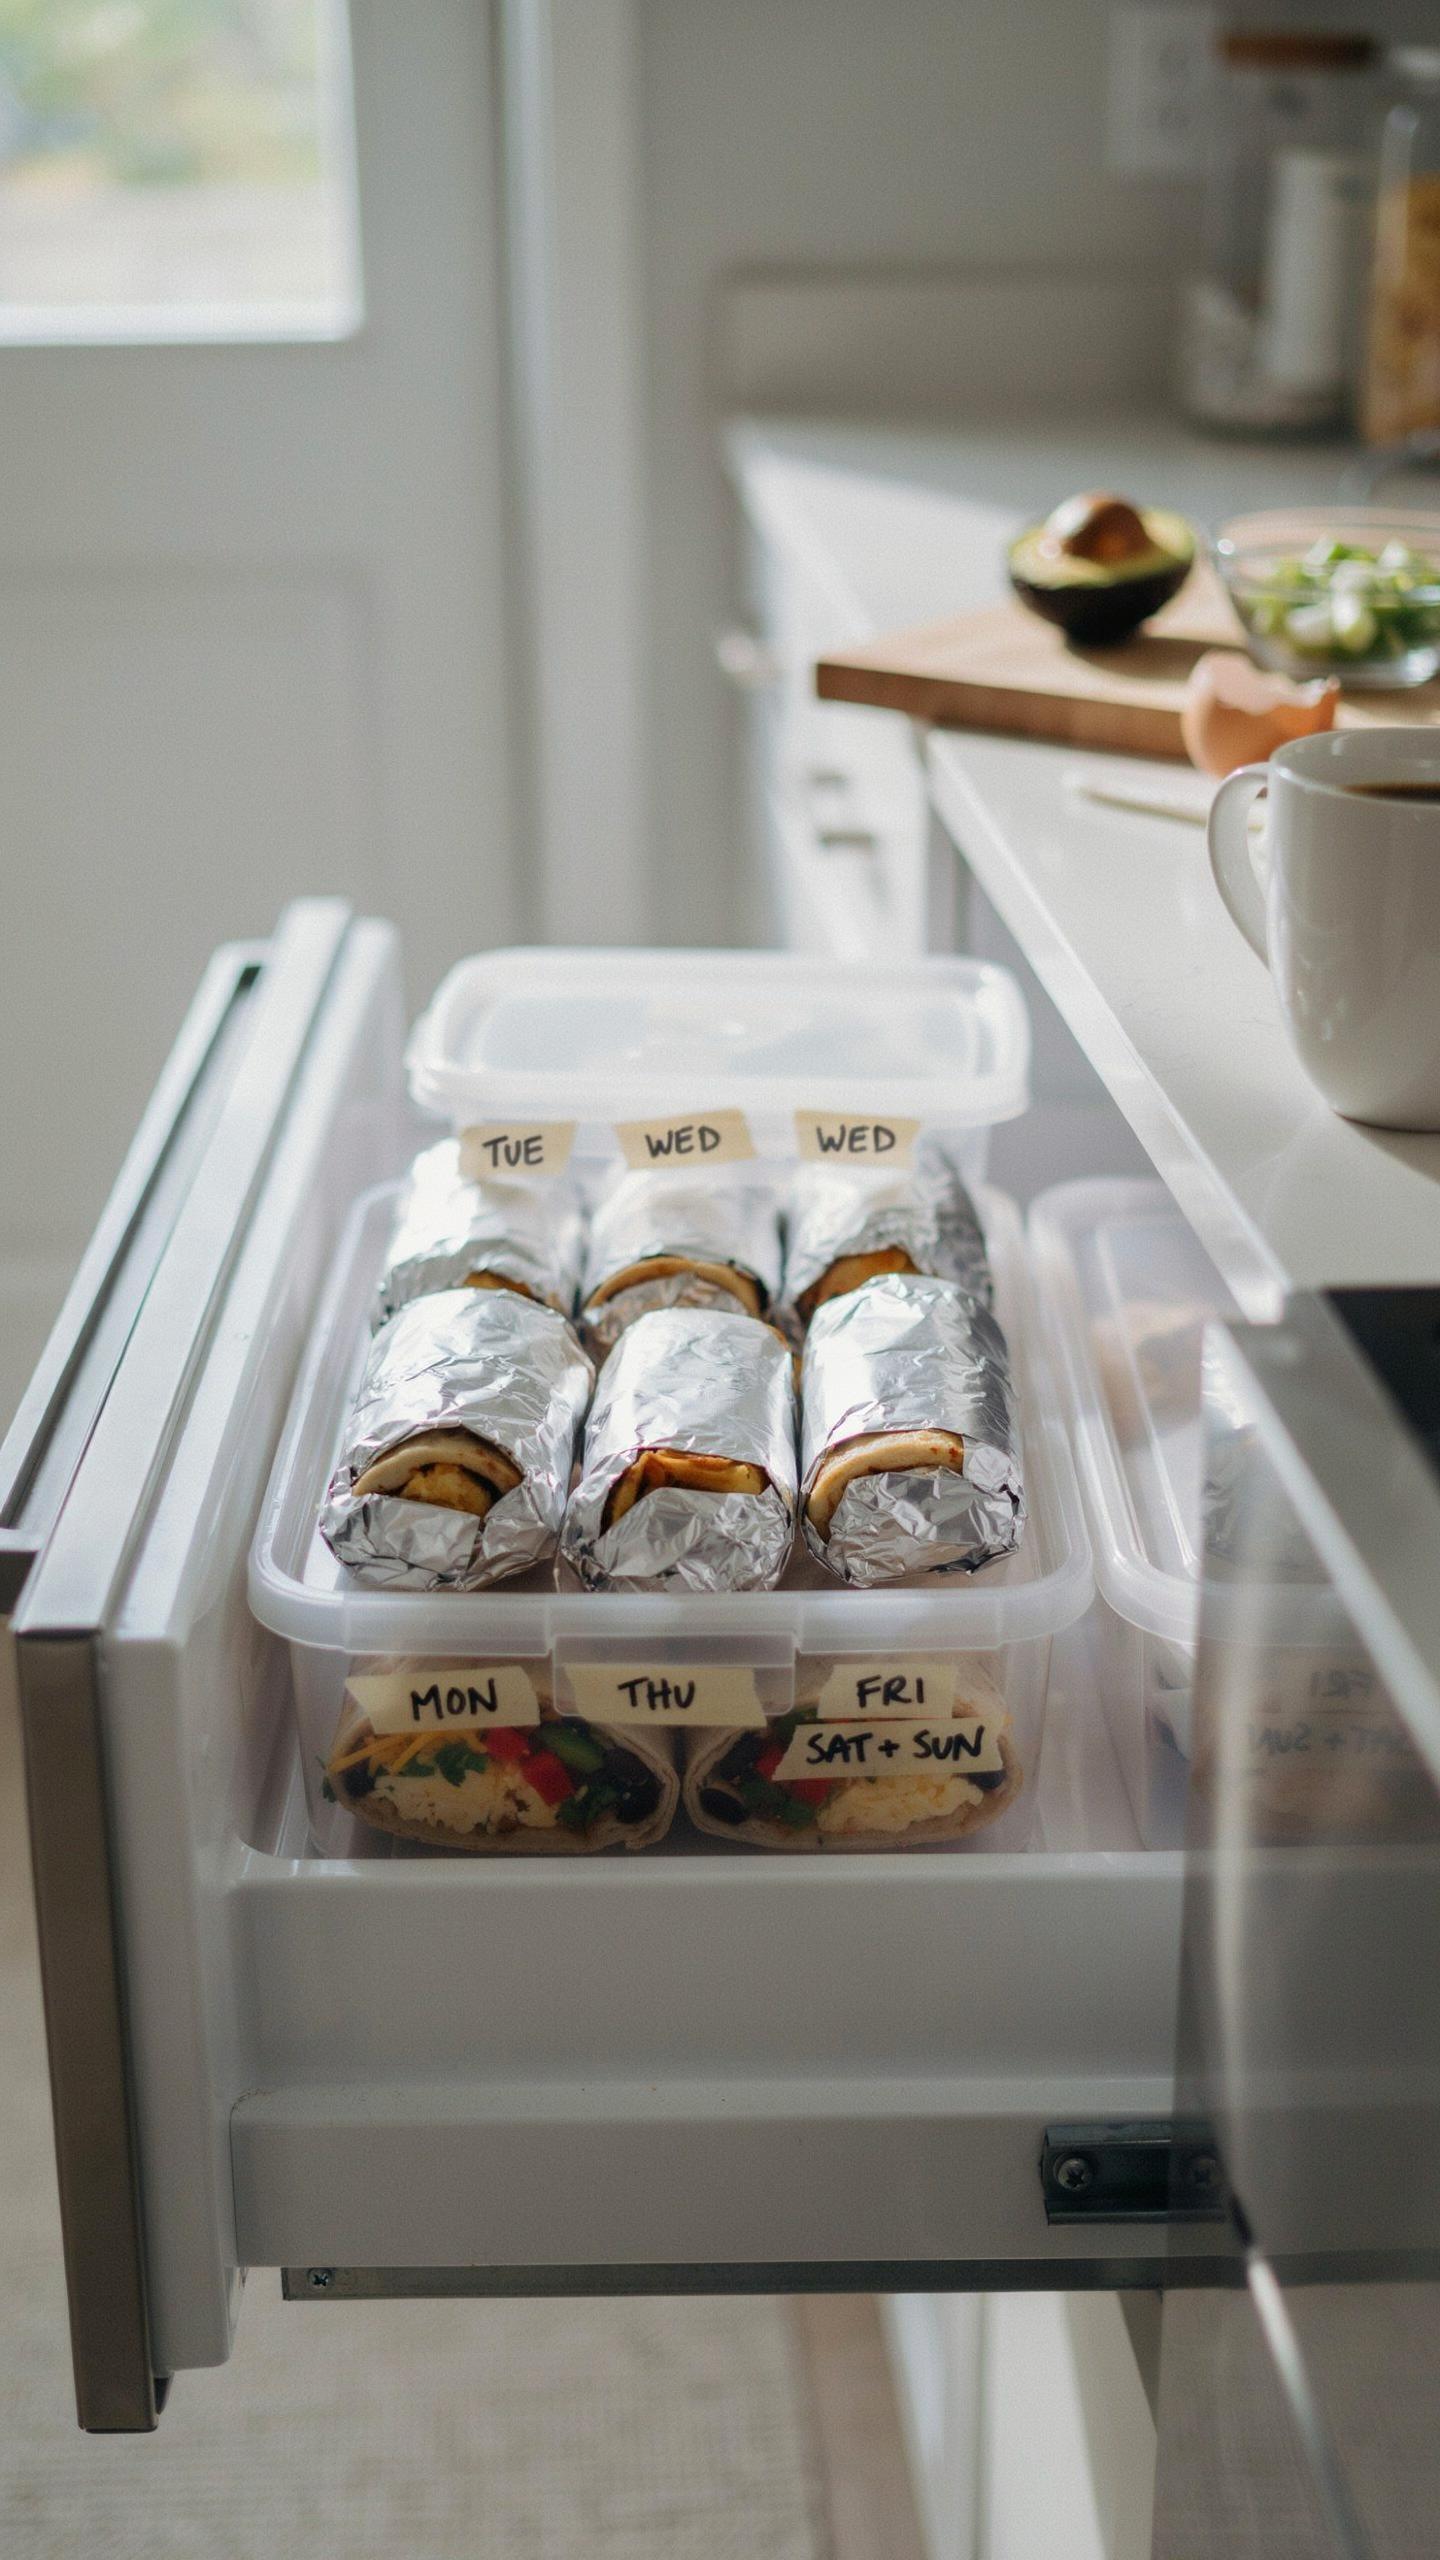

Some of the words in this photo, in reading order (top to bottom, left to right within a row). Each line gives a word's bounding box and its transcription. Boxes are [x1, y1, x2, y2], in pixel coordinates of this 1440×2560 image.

[481, 1134, 545, 1168] TUE
[644, 1125, 722, 1159] WED
[815, 1124, 897, 1154] WED
[410, 1678, 499, 1722] MON
[617, 1676, 697, 1711] THU
[856, 1674, 926, 1709] FRI
[805, 1732, 874, 1765] SAT
[877, 1739, 902, 1759] +
[912, 1725, 986, 1762] SUN
